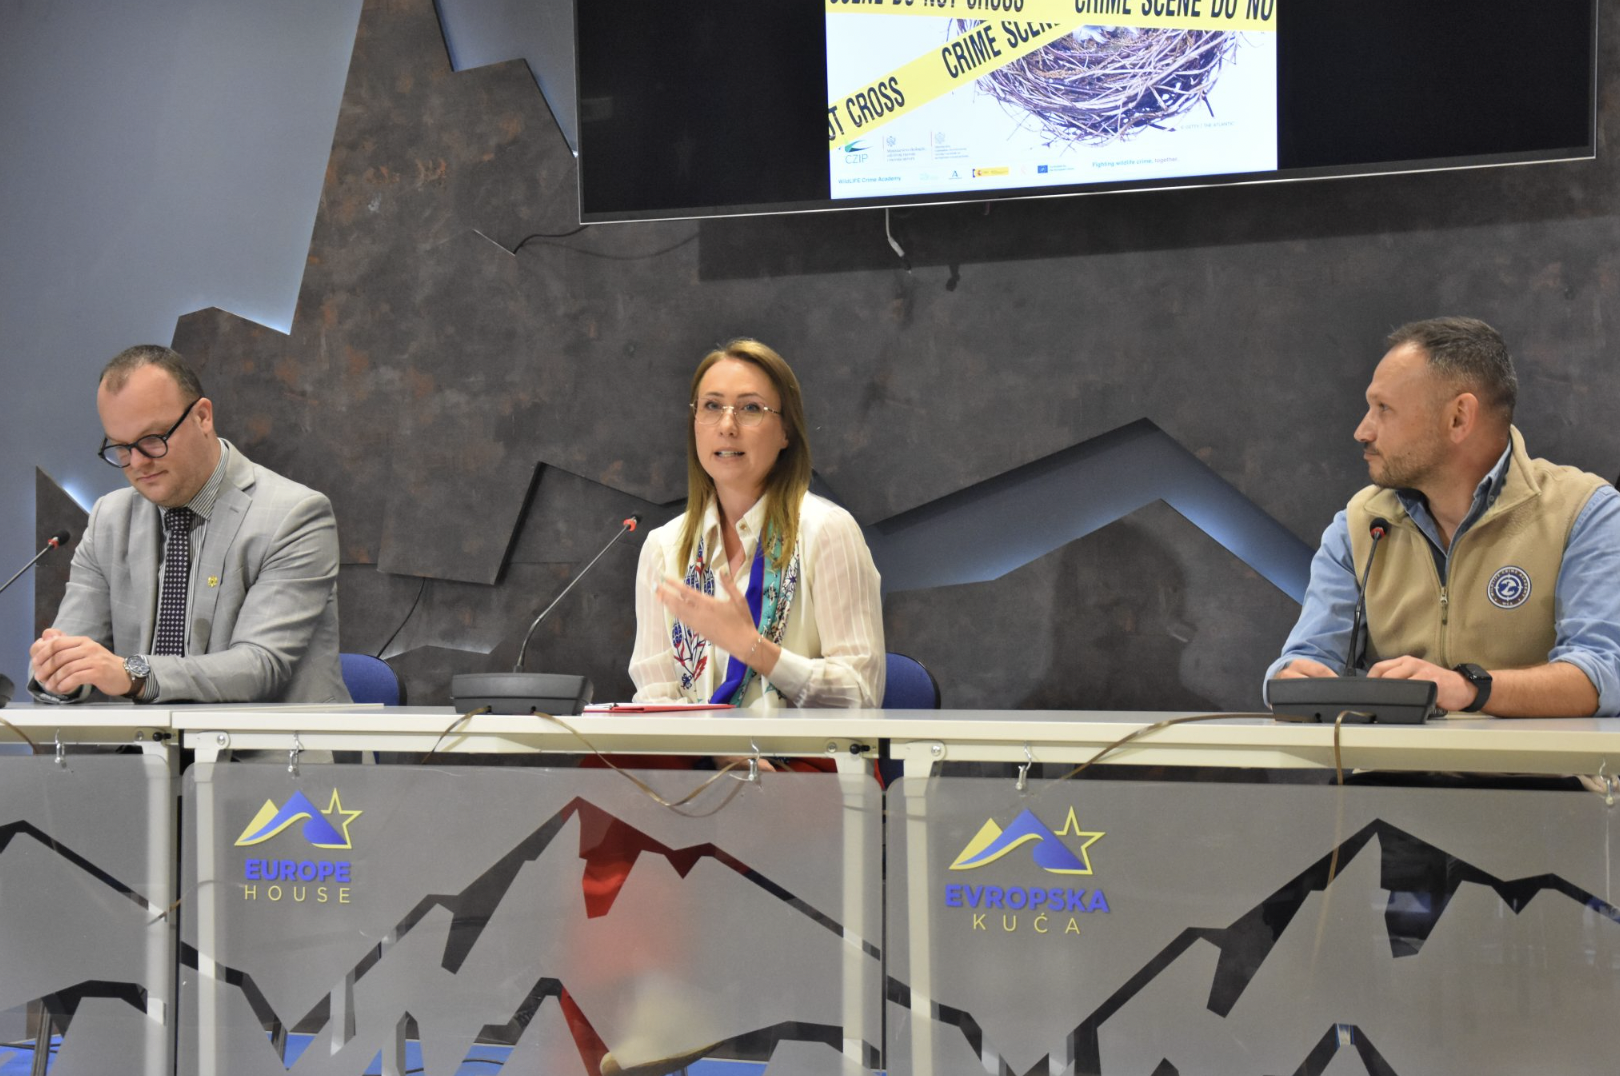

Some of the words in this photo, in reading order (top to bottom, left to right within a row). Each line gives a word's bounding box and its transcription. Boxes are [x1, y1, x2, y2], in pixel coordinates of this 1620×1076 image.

[846, 76, 905, 128] CROSS
[942, 25, 1002, 79] CRIME
[845, 153, 868, 164] CZIP
[245, 858, 352, 883] EUROPE
[244, 884, 351, 903] HOUSE
[945, 883, 1111, 913] EVROPSKA
[973, 912, 1081, 935] KUĆA
